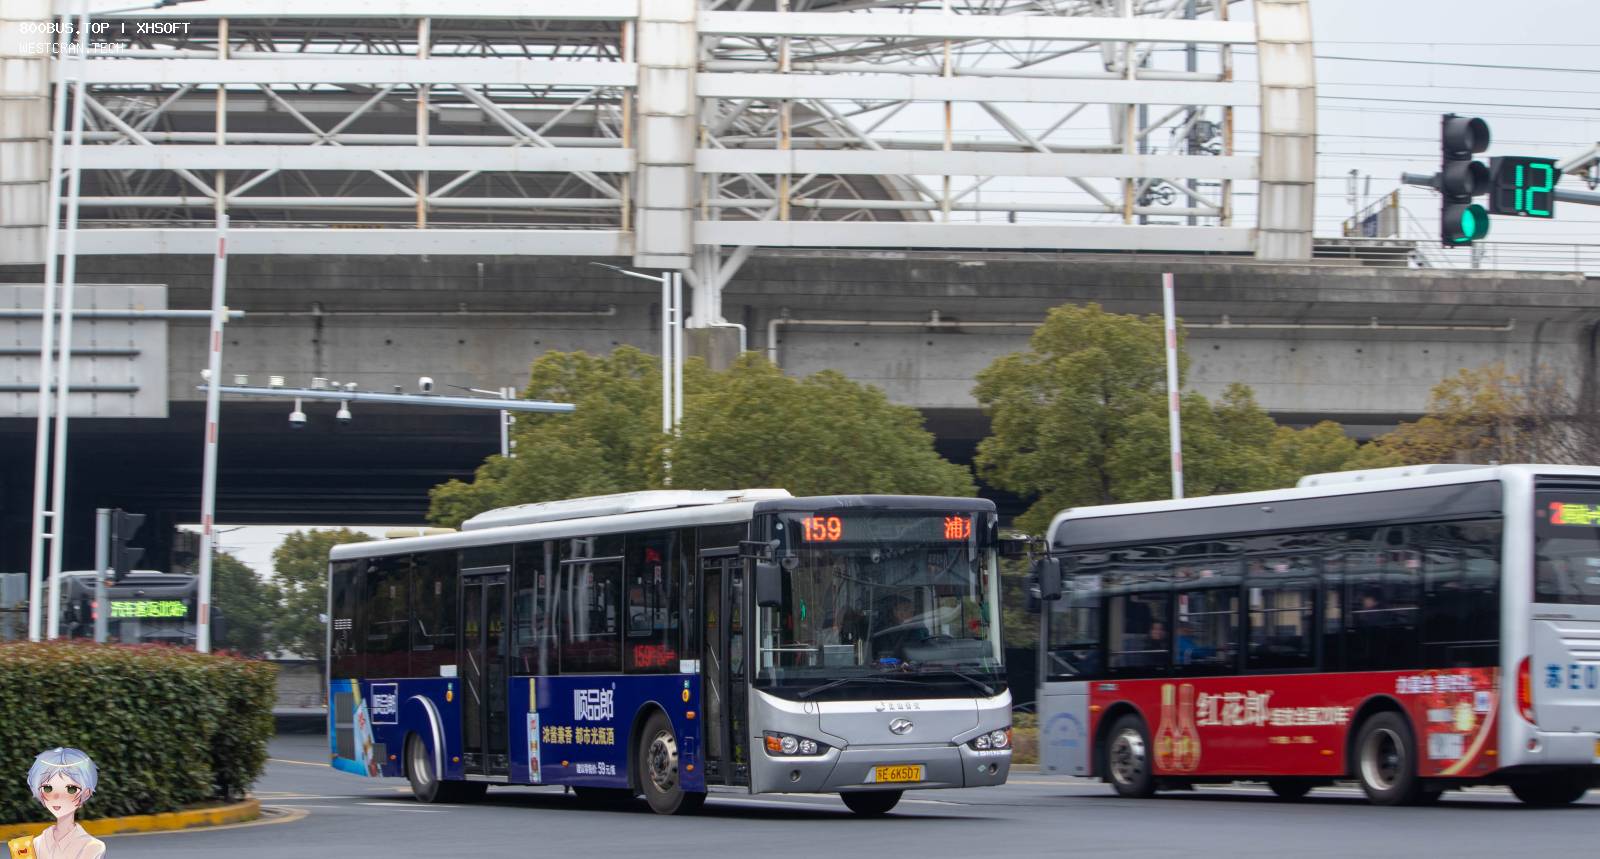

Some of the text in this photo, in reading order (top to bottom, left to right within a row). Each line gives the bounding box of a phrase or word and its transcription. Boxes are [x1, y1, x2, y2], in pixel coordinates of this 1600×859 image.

[1515, 163, 1553, 216] 12
[802, 516, 842, 541] 159
[574, 688, 614, 720] 顺品郎
[1196, 690, 1271, 727] 红花郎
